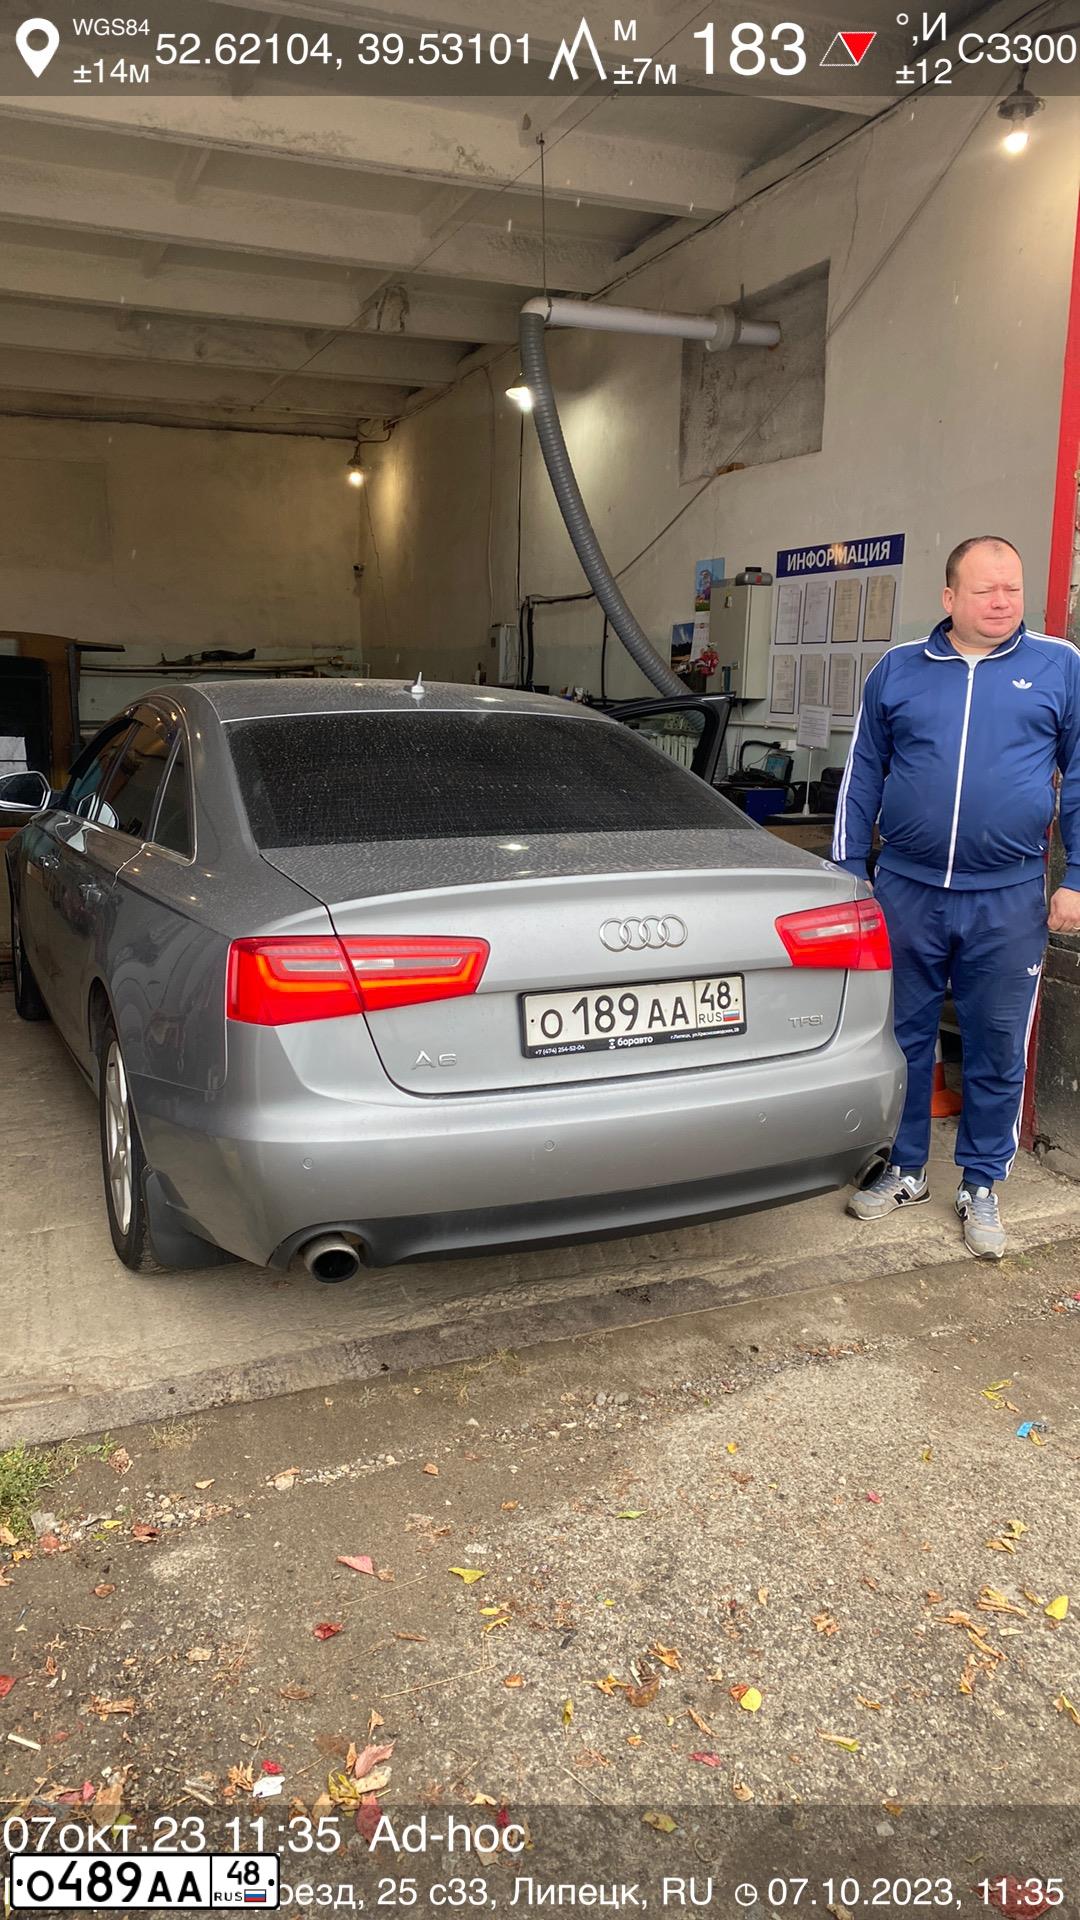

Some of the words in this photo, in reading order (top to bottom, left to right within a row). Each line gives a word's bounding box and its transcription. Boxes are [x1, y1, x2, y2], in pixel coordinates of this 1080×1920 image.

[786, 540, 891, 572] ИНФОРМАЦИЯ
[700, 981, 732, 1011] 48
[699, 1012, 723, 1024] RUS
[788, 1014, 824, 1028] TFSI
[617, 1035, 654, 1047] боравто
[411, 1050, 457, 1070] A6
[893, 1187, 912, 1205] N
